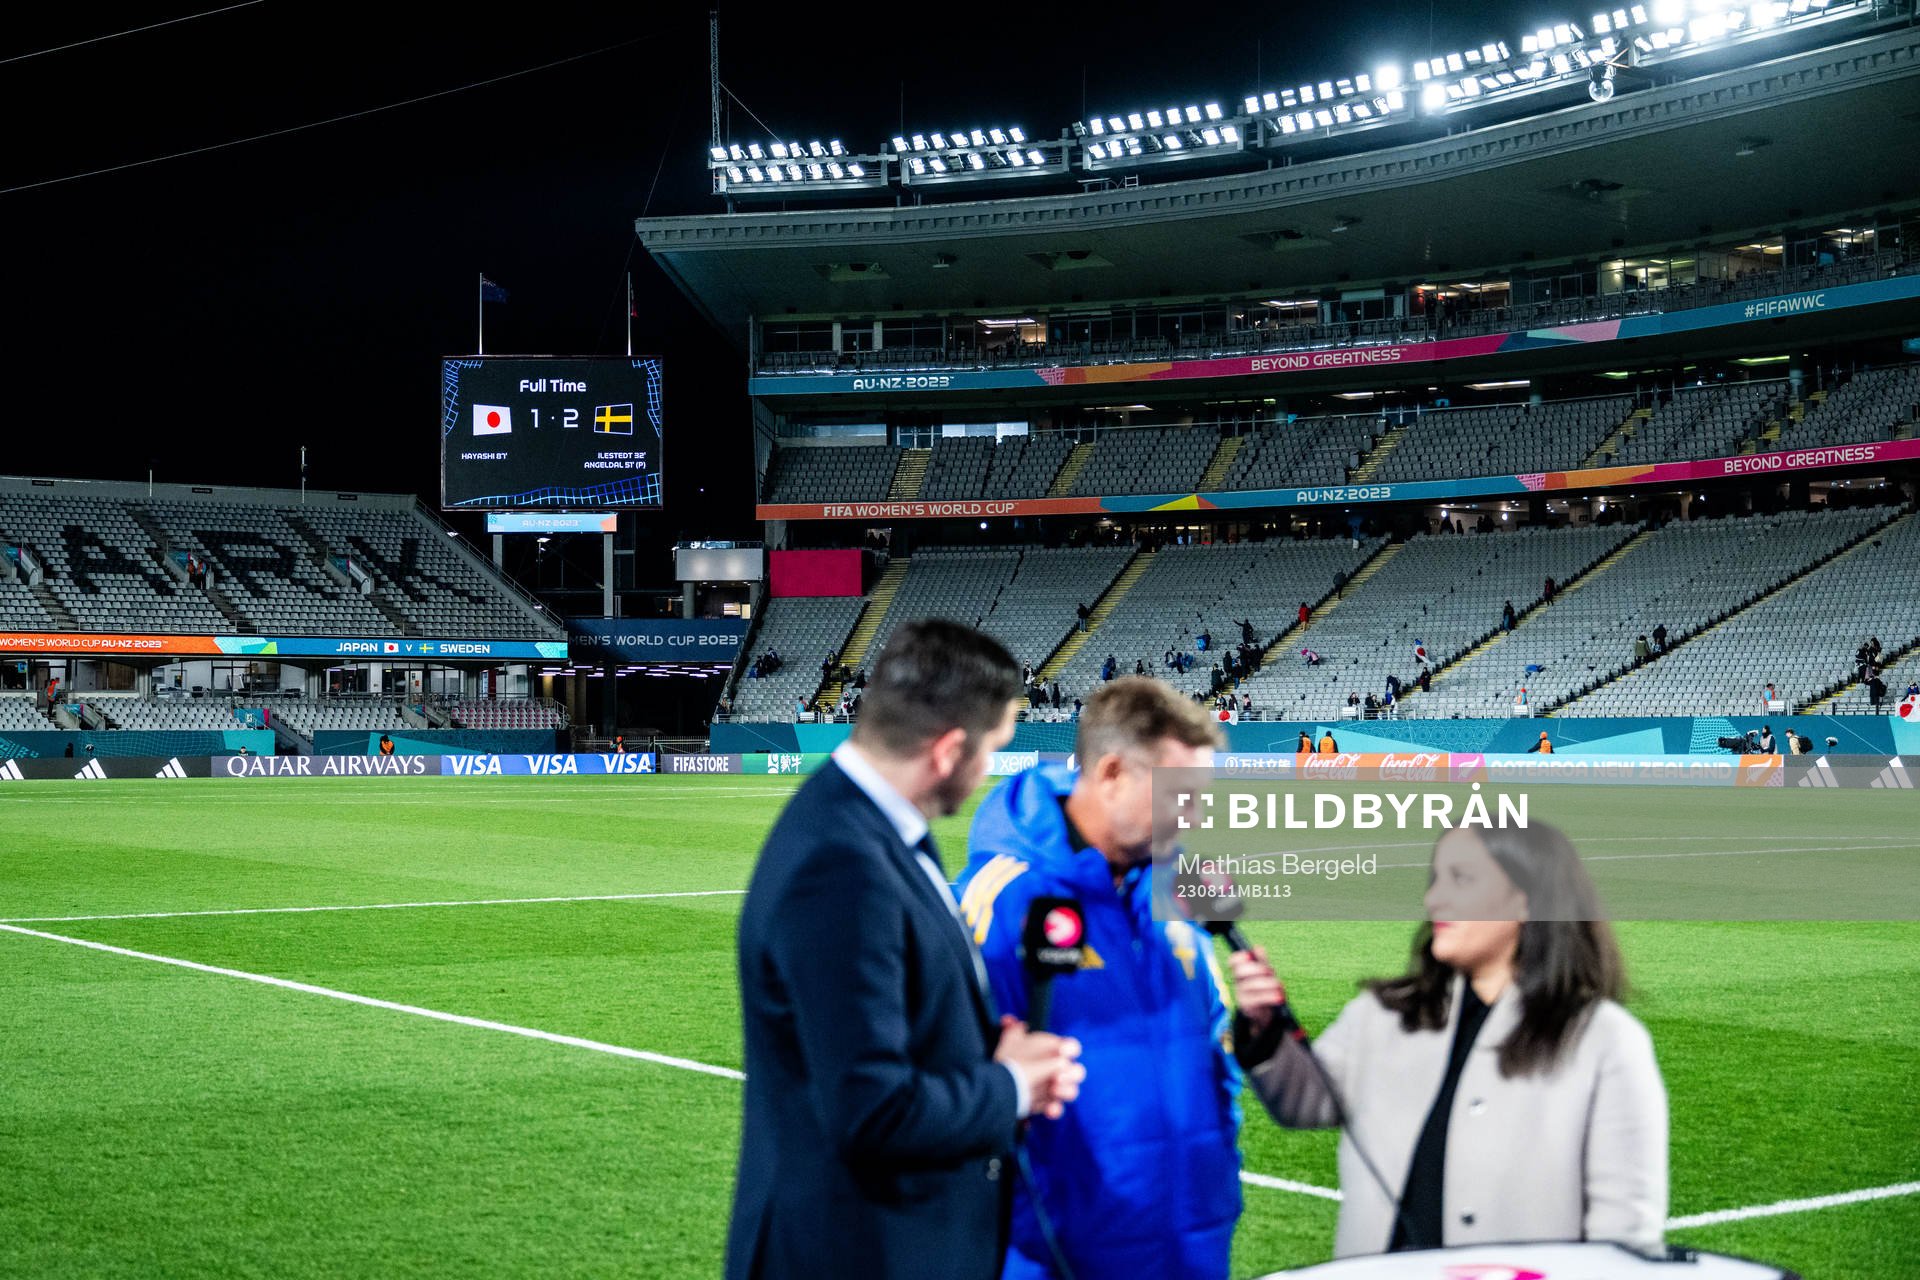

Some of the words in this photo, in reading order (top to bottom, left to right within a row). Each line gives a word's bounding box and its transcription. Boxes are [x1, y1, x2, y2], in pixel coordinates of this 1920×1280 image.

[1744, 293, 1825, 318] #FIFAWWC
[1251, 355, 1310, 371] BEYOND
[1313, 349, 1401, 366] GREATNESS
[520, 379, 547, 393] Full
[550, 379, 587, 393] Time
[530, 408, 539, 428] 1
[563, 408, 579, 428] 2
[584, 461, 624, 469] ANGELDAL
[635, 461, 646, 469] (P)
[1724, 455, 1782, 473] BEYOND
[1786, 446, 1875, 467] GREATNESS
[823, 505, 853, 517] FIFA
[856, 504, 925, 517] WOMEN'S
[928, 503, 981, 515] WORLD
[985, 502, 1015, 514] CUP
[0, 638, 45, 647] WOMEN'S
[46, 638, 80, 647] WORLD
[81, 639, 100, 648] CUP
[336, 642, 378, 652] JAPAN
[440, 643, 491, 654] SWEDEN
[615, 635, 663, 646] WORLD
[668, 635, 696, 646] CUP
[227, 755, 311, 777] QATAR
[322, 755, 426, 775] AIRWAYS
[445, 755, 502, 775] VISA
[523, 754, 578, 774] VISA
[598, 753, 652, 774] VISA
[1000, 755, 1035, 773] xero
[1490, 760, 1588, 778] AOTEAROA
[1593, 760, 1636, 778] NEW
[1639, 760, 1732, 780] ZEALAND
